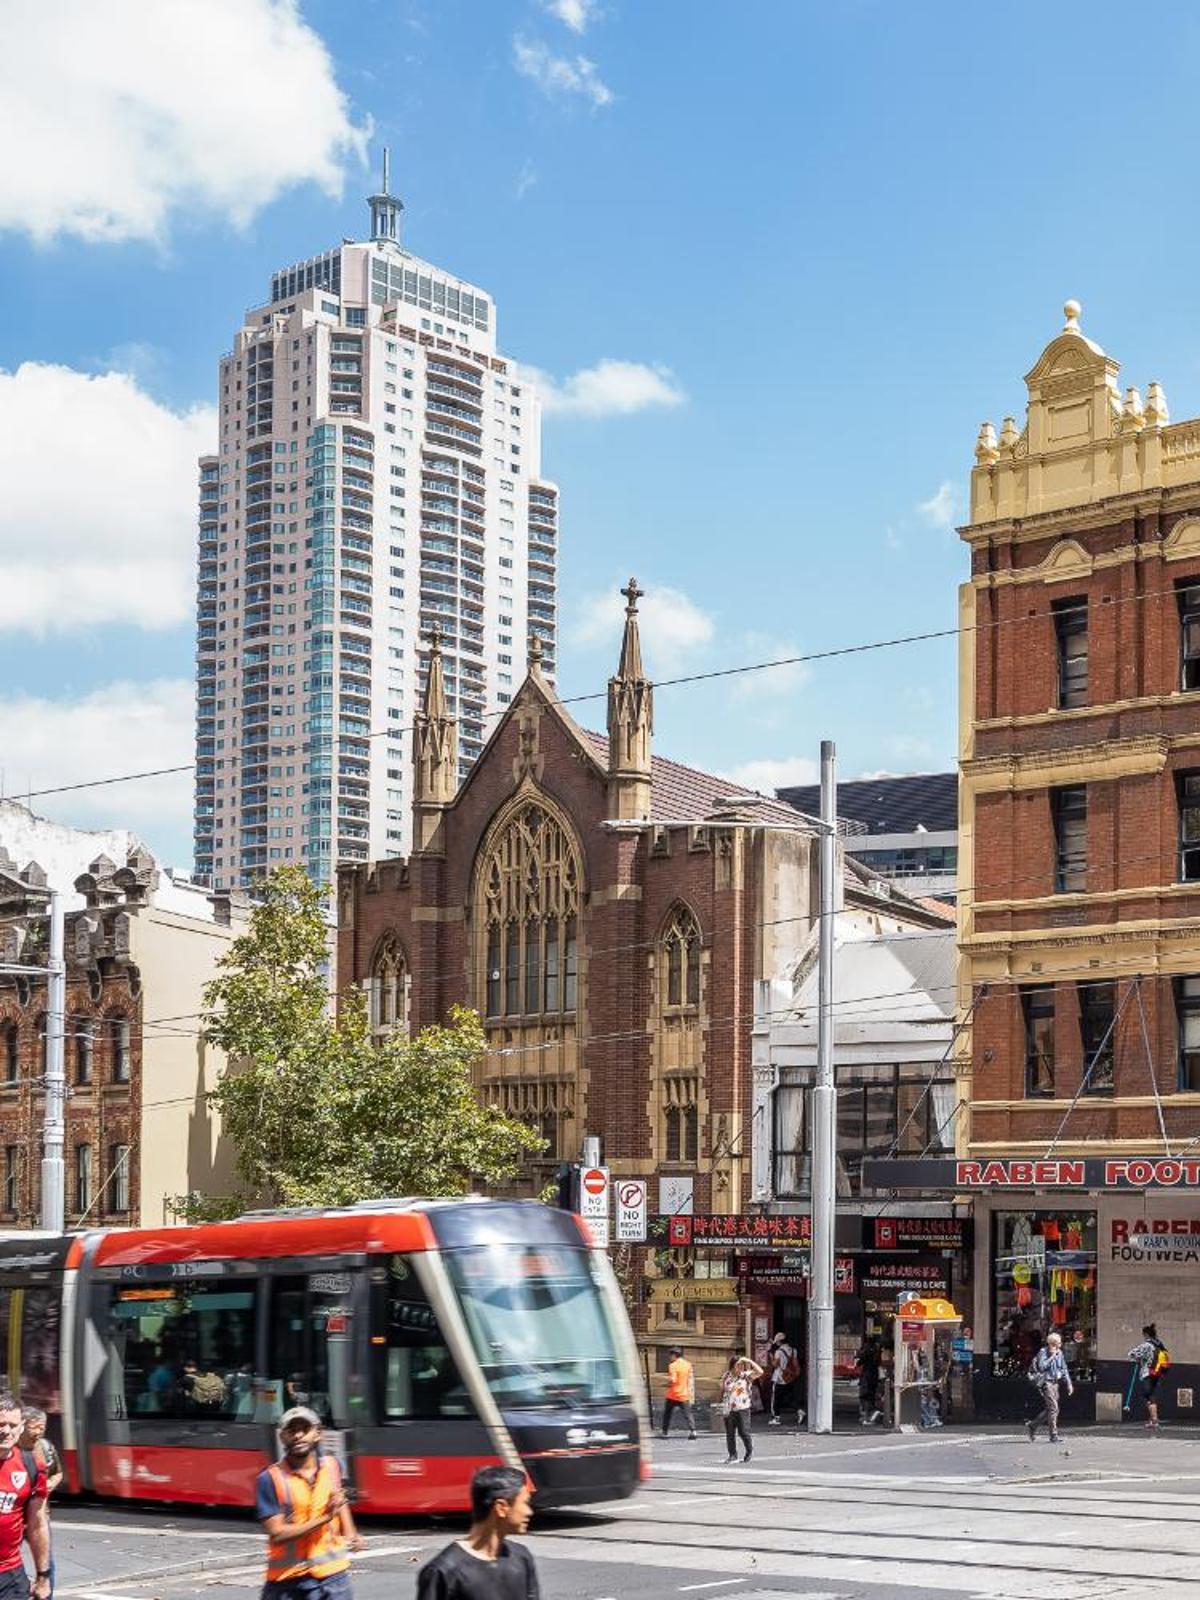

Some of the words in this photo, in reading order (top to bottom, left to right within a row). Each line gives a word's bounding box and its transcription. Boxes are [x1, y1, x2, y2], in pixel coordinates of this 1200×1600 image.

[956, 1161, 1085, 1185] RABEN
[588, 1197, 602, 1205] NO
[624, 1210, 639, 1220] NO
[929, 1281, 946, 1289] CAFE
